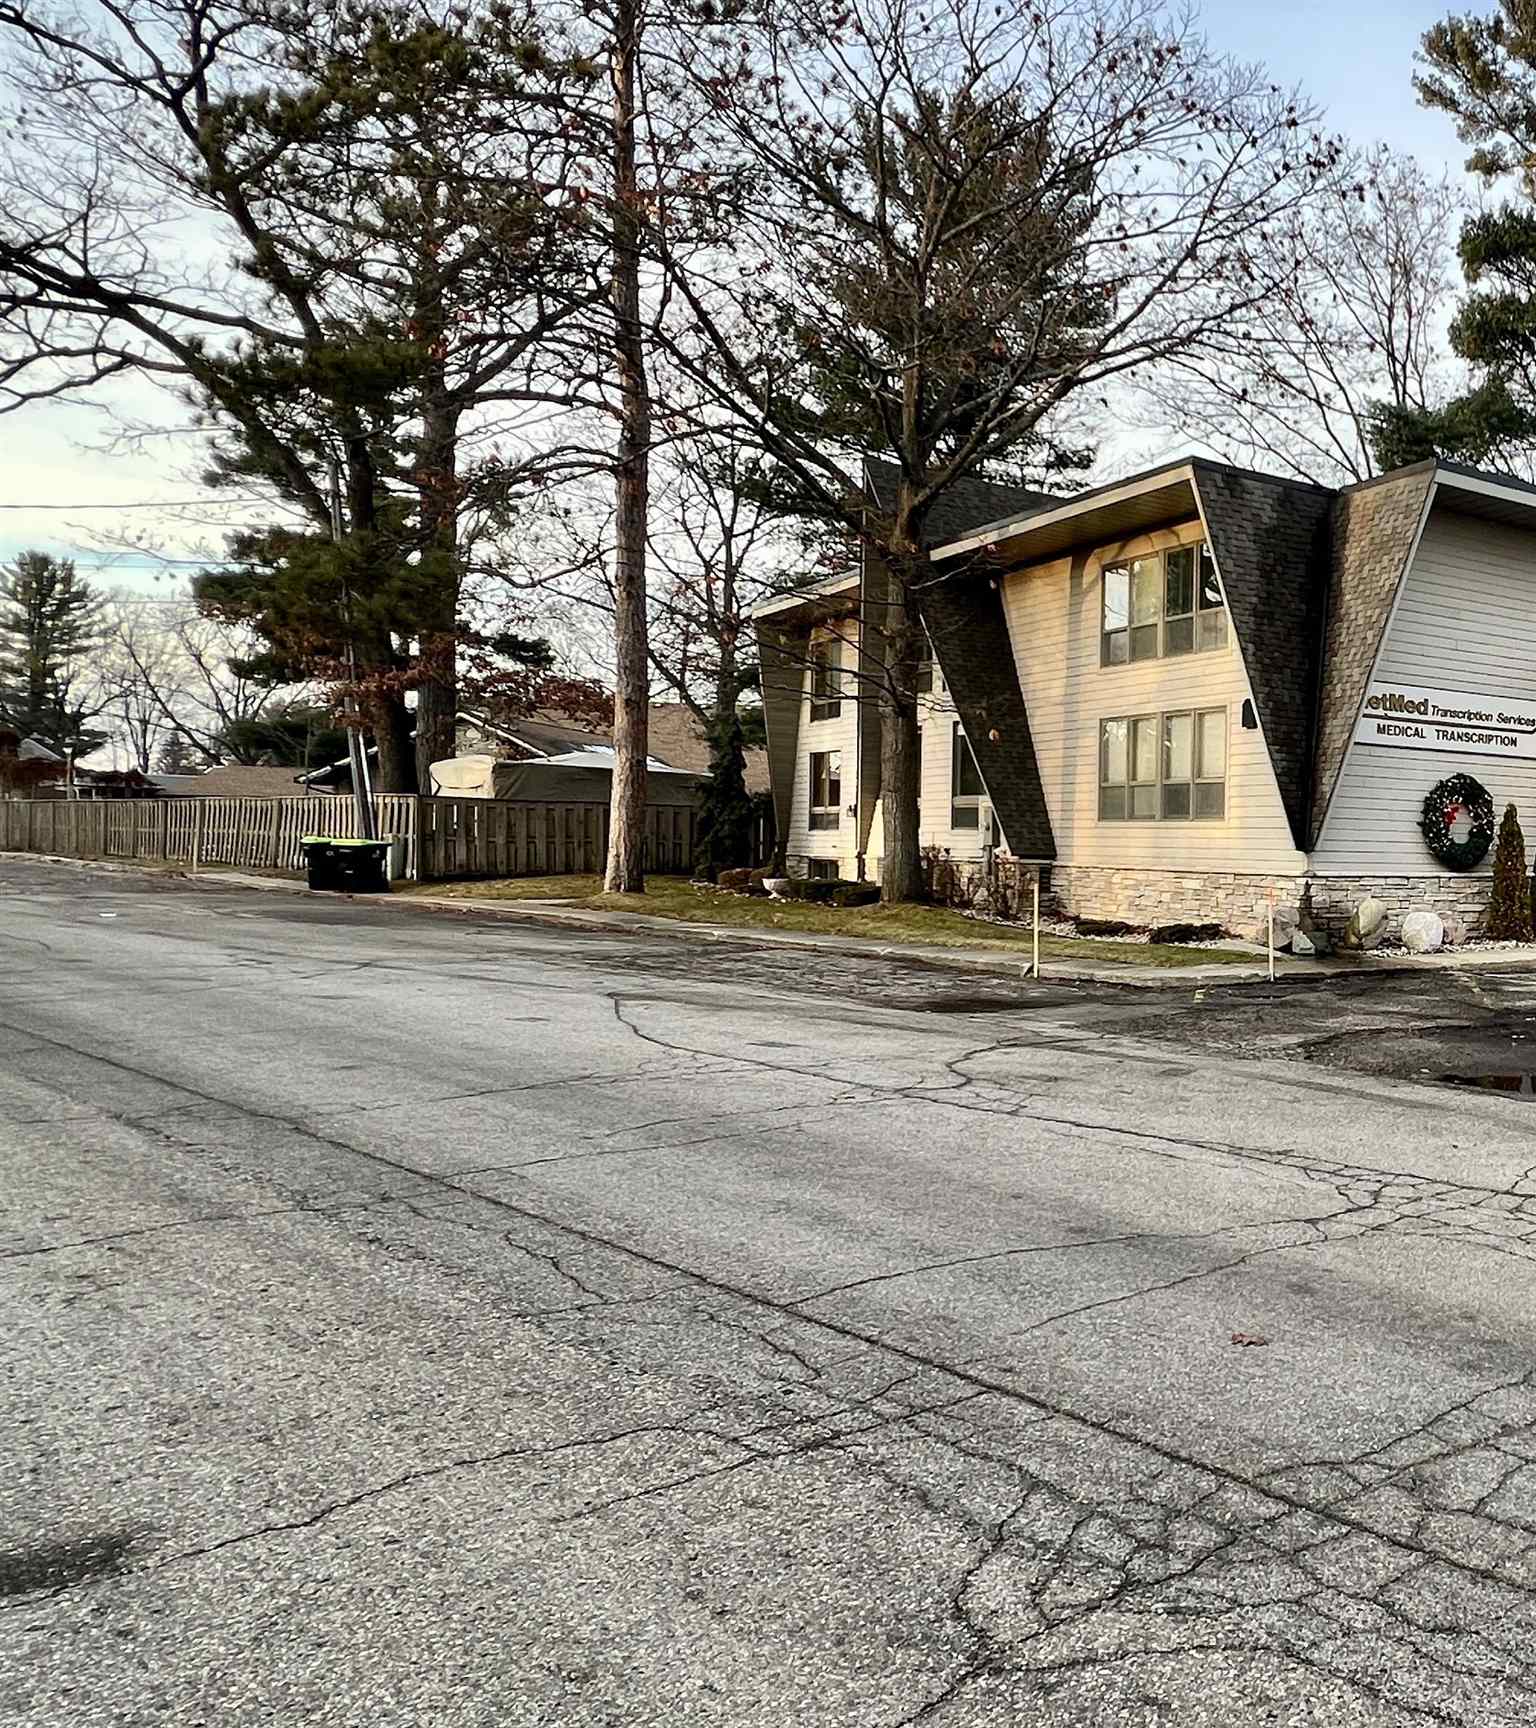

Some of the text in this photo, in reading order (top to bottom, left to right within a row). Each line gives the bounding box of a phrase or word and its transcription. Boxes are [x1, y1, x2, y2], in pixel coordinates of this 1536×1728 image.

[1365, 693, 1536, 727] etMed Transcription Services
[1376, 723, 1518, 747] MEDICAL TRANSCRIPTION
